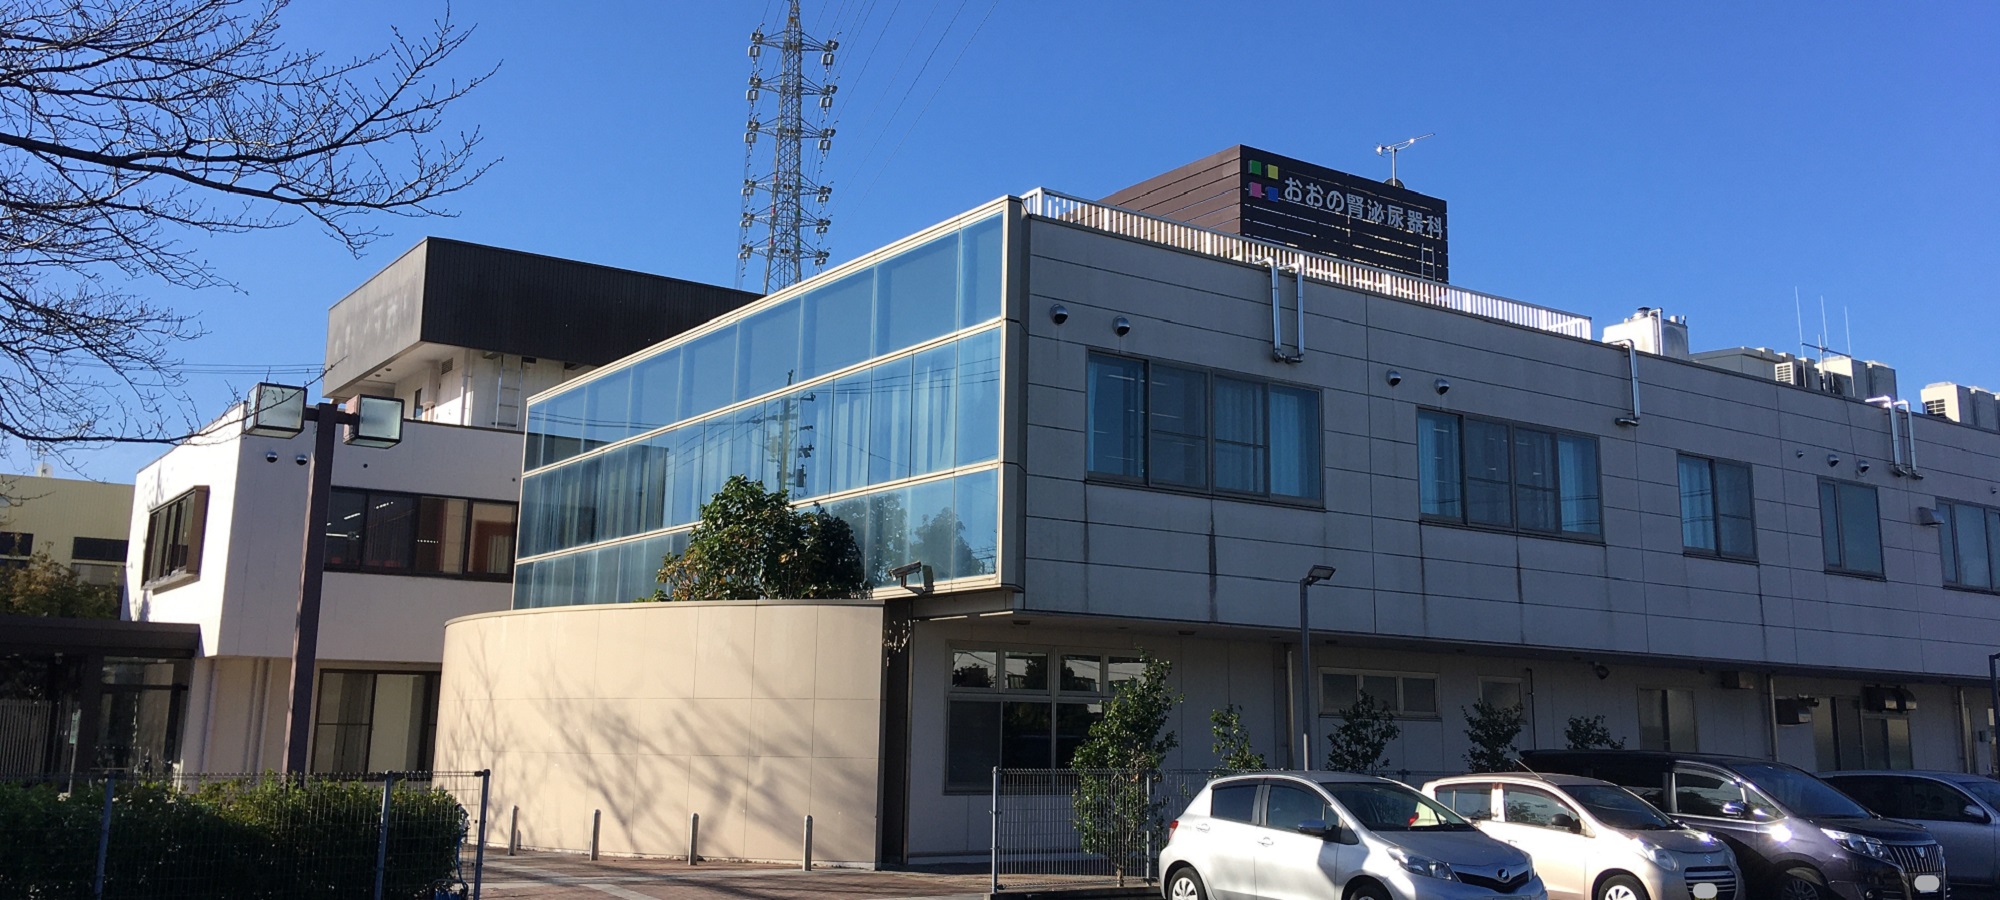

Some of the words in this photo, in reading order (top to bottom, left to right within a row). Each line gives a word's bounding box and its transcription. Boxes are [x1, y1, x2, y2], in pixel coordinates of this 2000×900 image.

[1284, 177, 1443, 239] おおの腎泌尿器科
